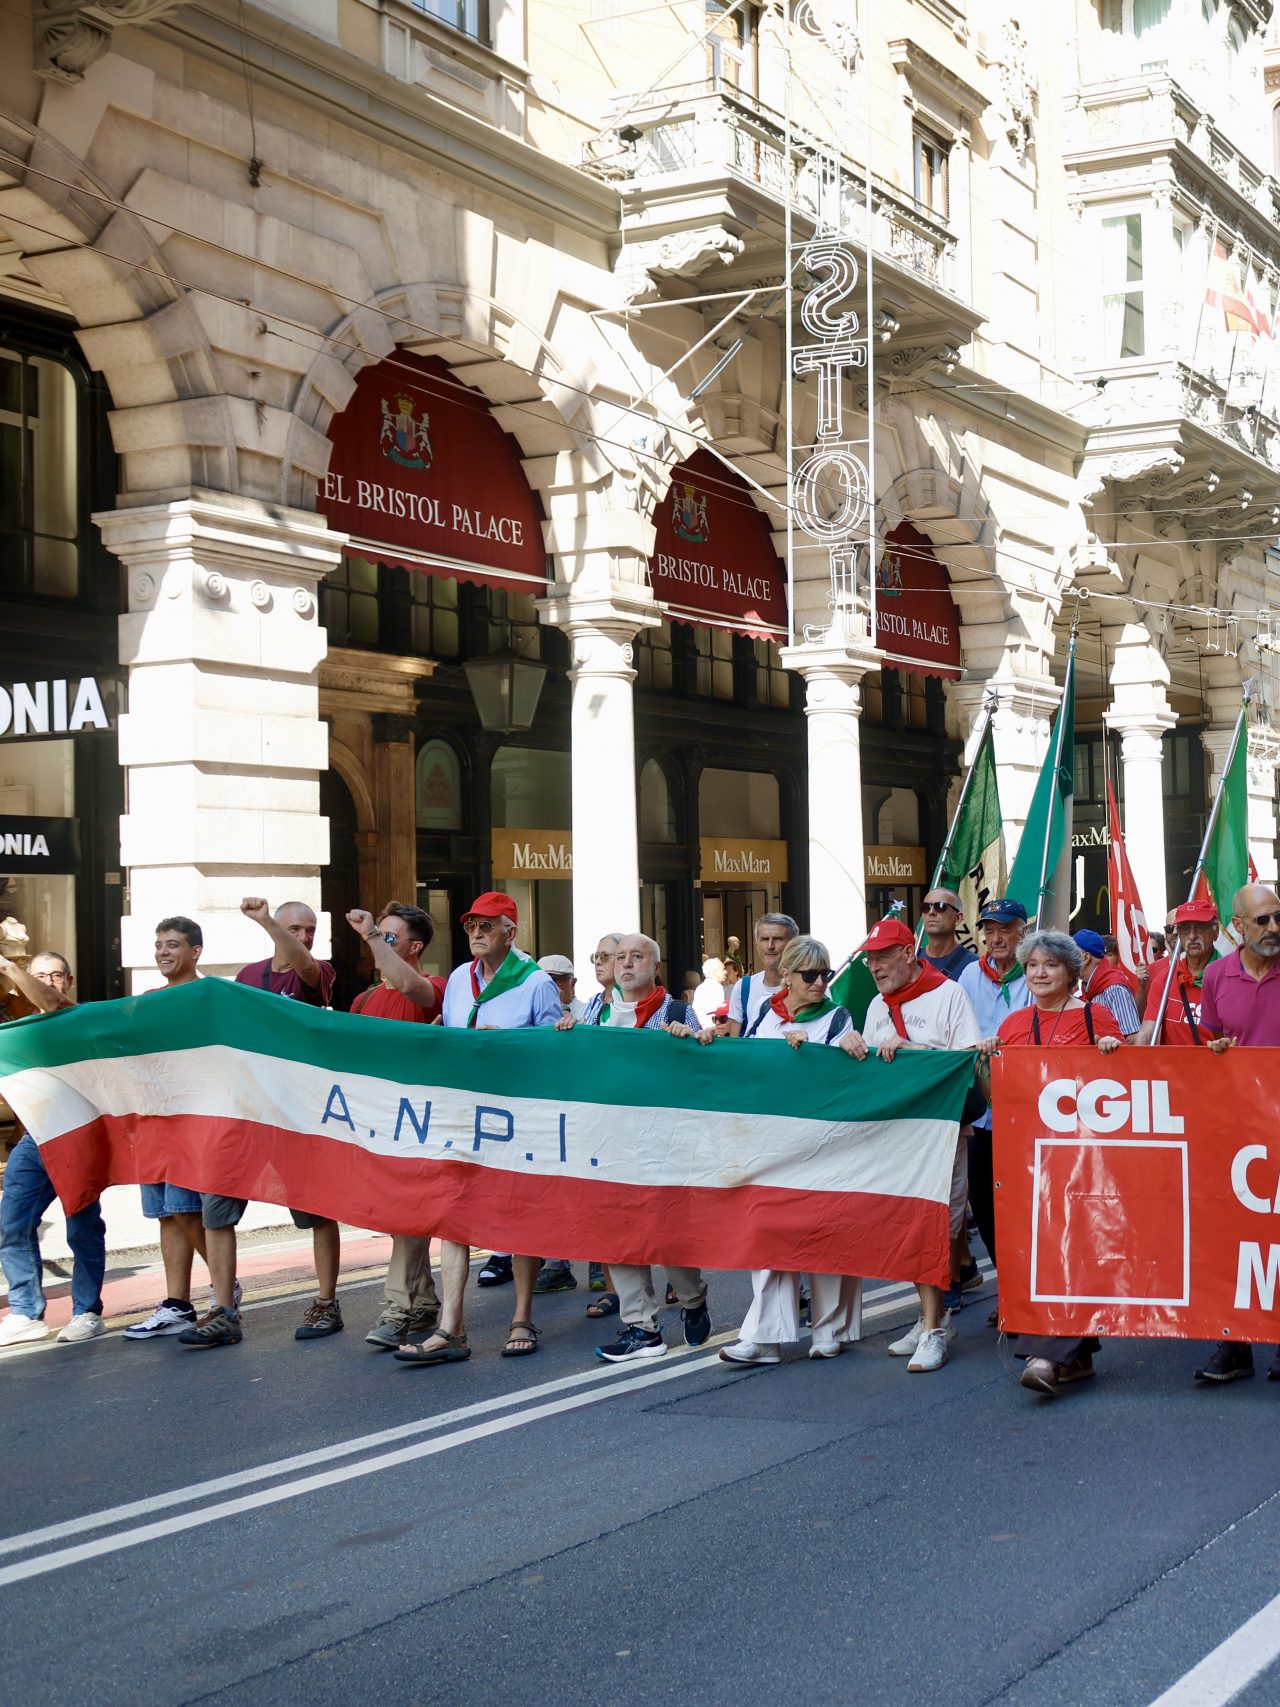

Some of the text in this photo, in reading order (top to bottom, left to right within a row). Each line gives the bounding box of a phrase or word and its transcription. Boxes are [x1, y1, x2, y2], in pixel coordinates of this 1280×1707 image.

[315, 471, 524, 546] EL BRISTOL PALACE
[657, 553, 772, 602] BRISTOL PALACE
[912, 618, 950, 646] PALACE
[713, 850, 771, 874] MaxMara
[867, 855, 913, 878] MaxMara
[1038, 1078, 1184, 1134] CGIL
